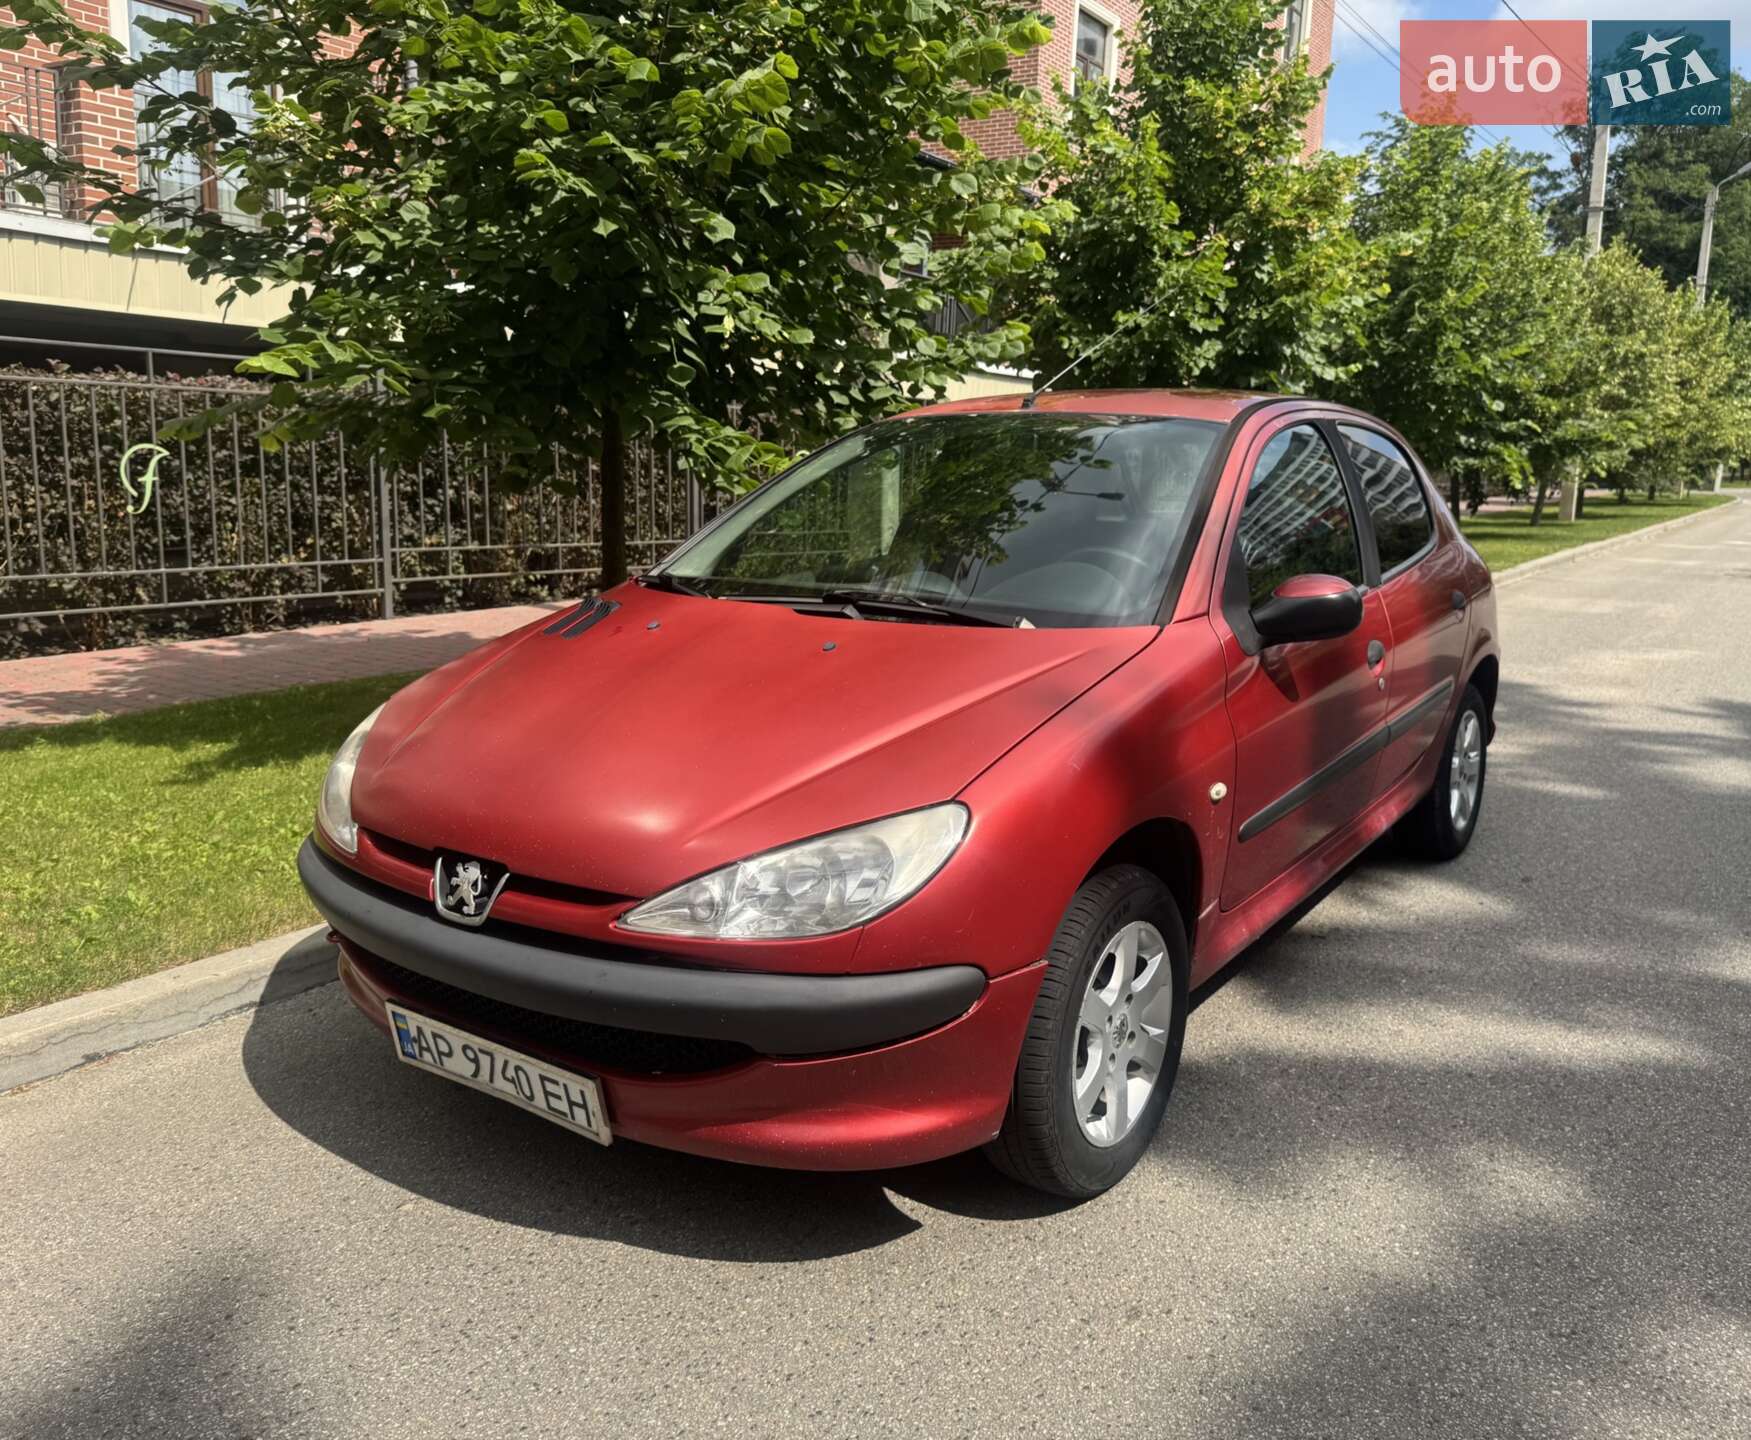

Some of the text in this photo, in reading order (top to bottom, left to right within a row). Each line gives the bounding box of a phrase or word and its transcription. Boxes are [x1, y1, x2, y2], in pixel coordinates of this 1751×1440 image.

[416, 1025, 593, 1128] AP 9740 EH
